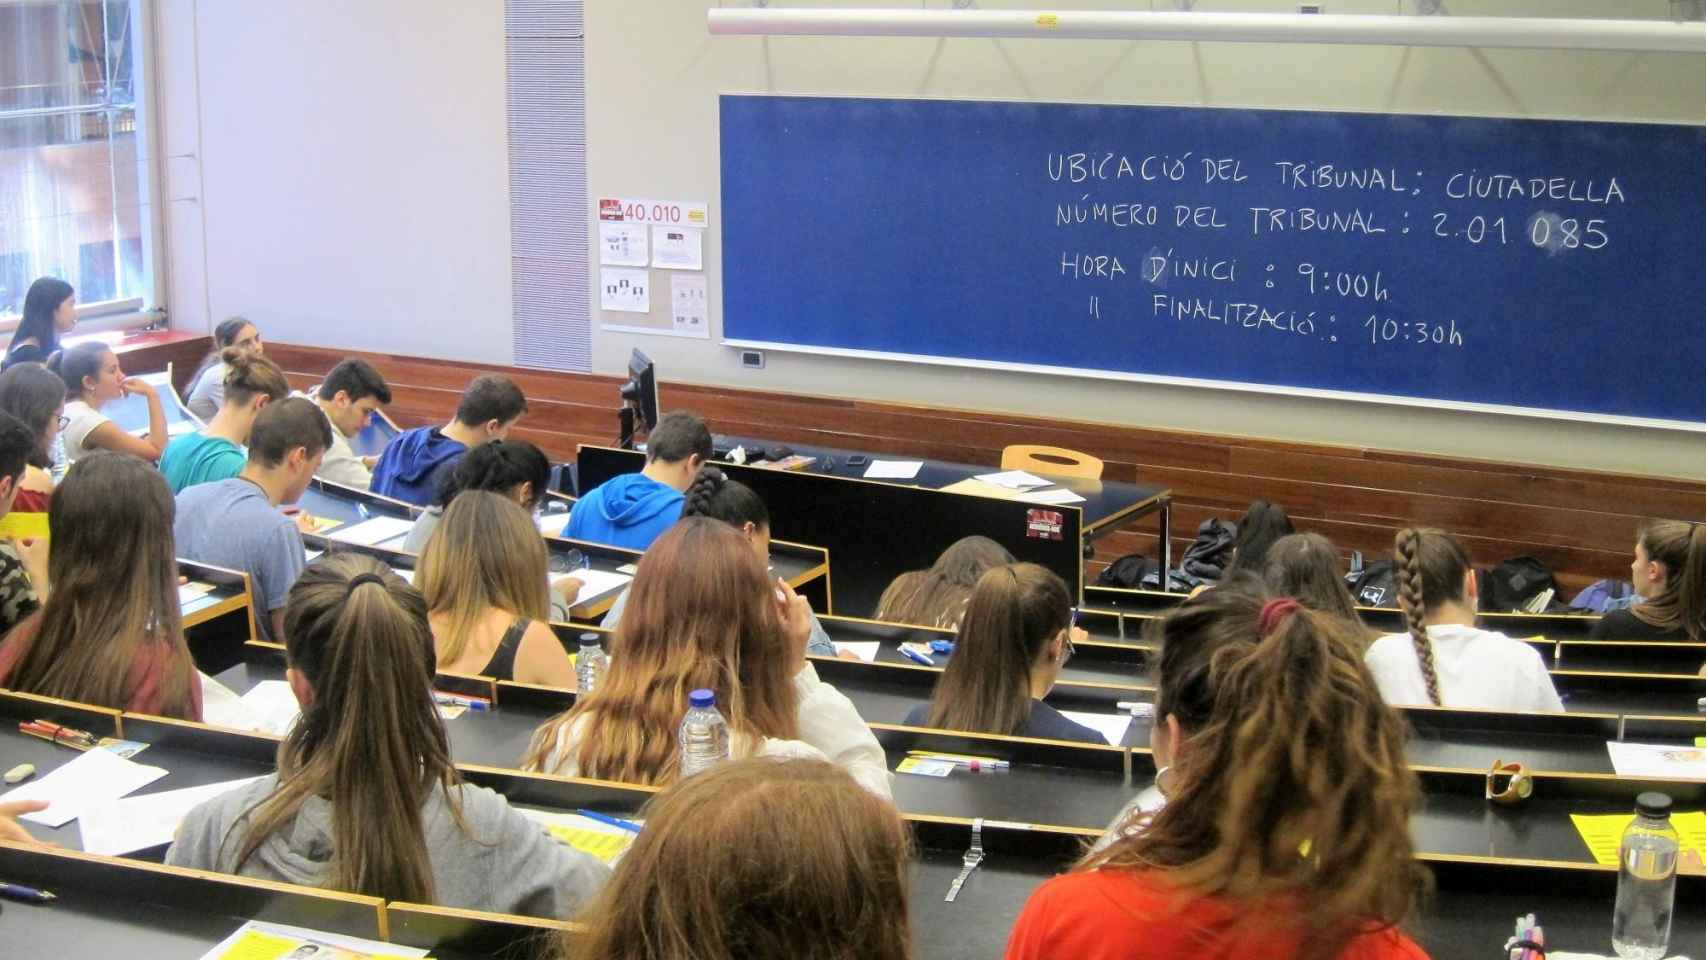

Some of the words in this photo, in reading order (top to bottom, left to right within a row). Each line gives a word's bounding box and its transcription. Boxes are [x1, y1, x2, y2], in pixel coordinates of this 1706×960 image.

[1048, 152, 1192, 182] UBICACIÓ
[1202, 158, 1248, 185] DEL
[1446, 168, 1625, 203] CIUTADELLA
[624, 203, 681, 223] 40.010
[1057, 194, 1158, 227] NÚMERO
[1175, 205, 1227, 228] DEL
[1532, 217, 1609, 249] 085
[1061, 252, 1126, 281] HORA
[1298, 263, 1388, 301] 9:00h
[1365, 314, 1463, 346] 10:30h
